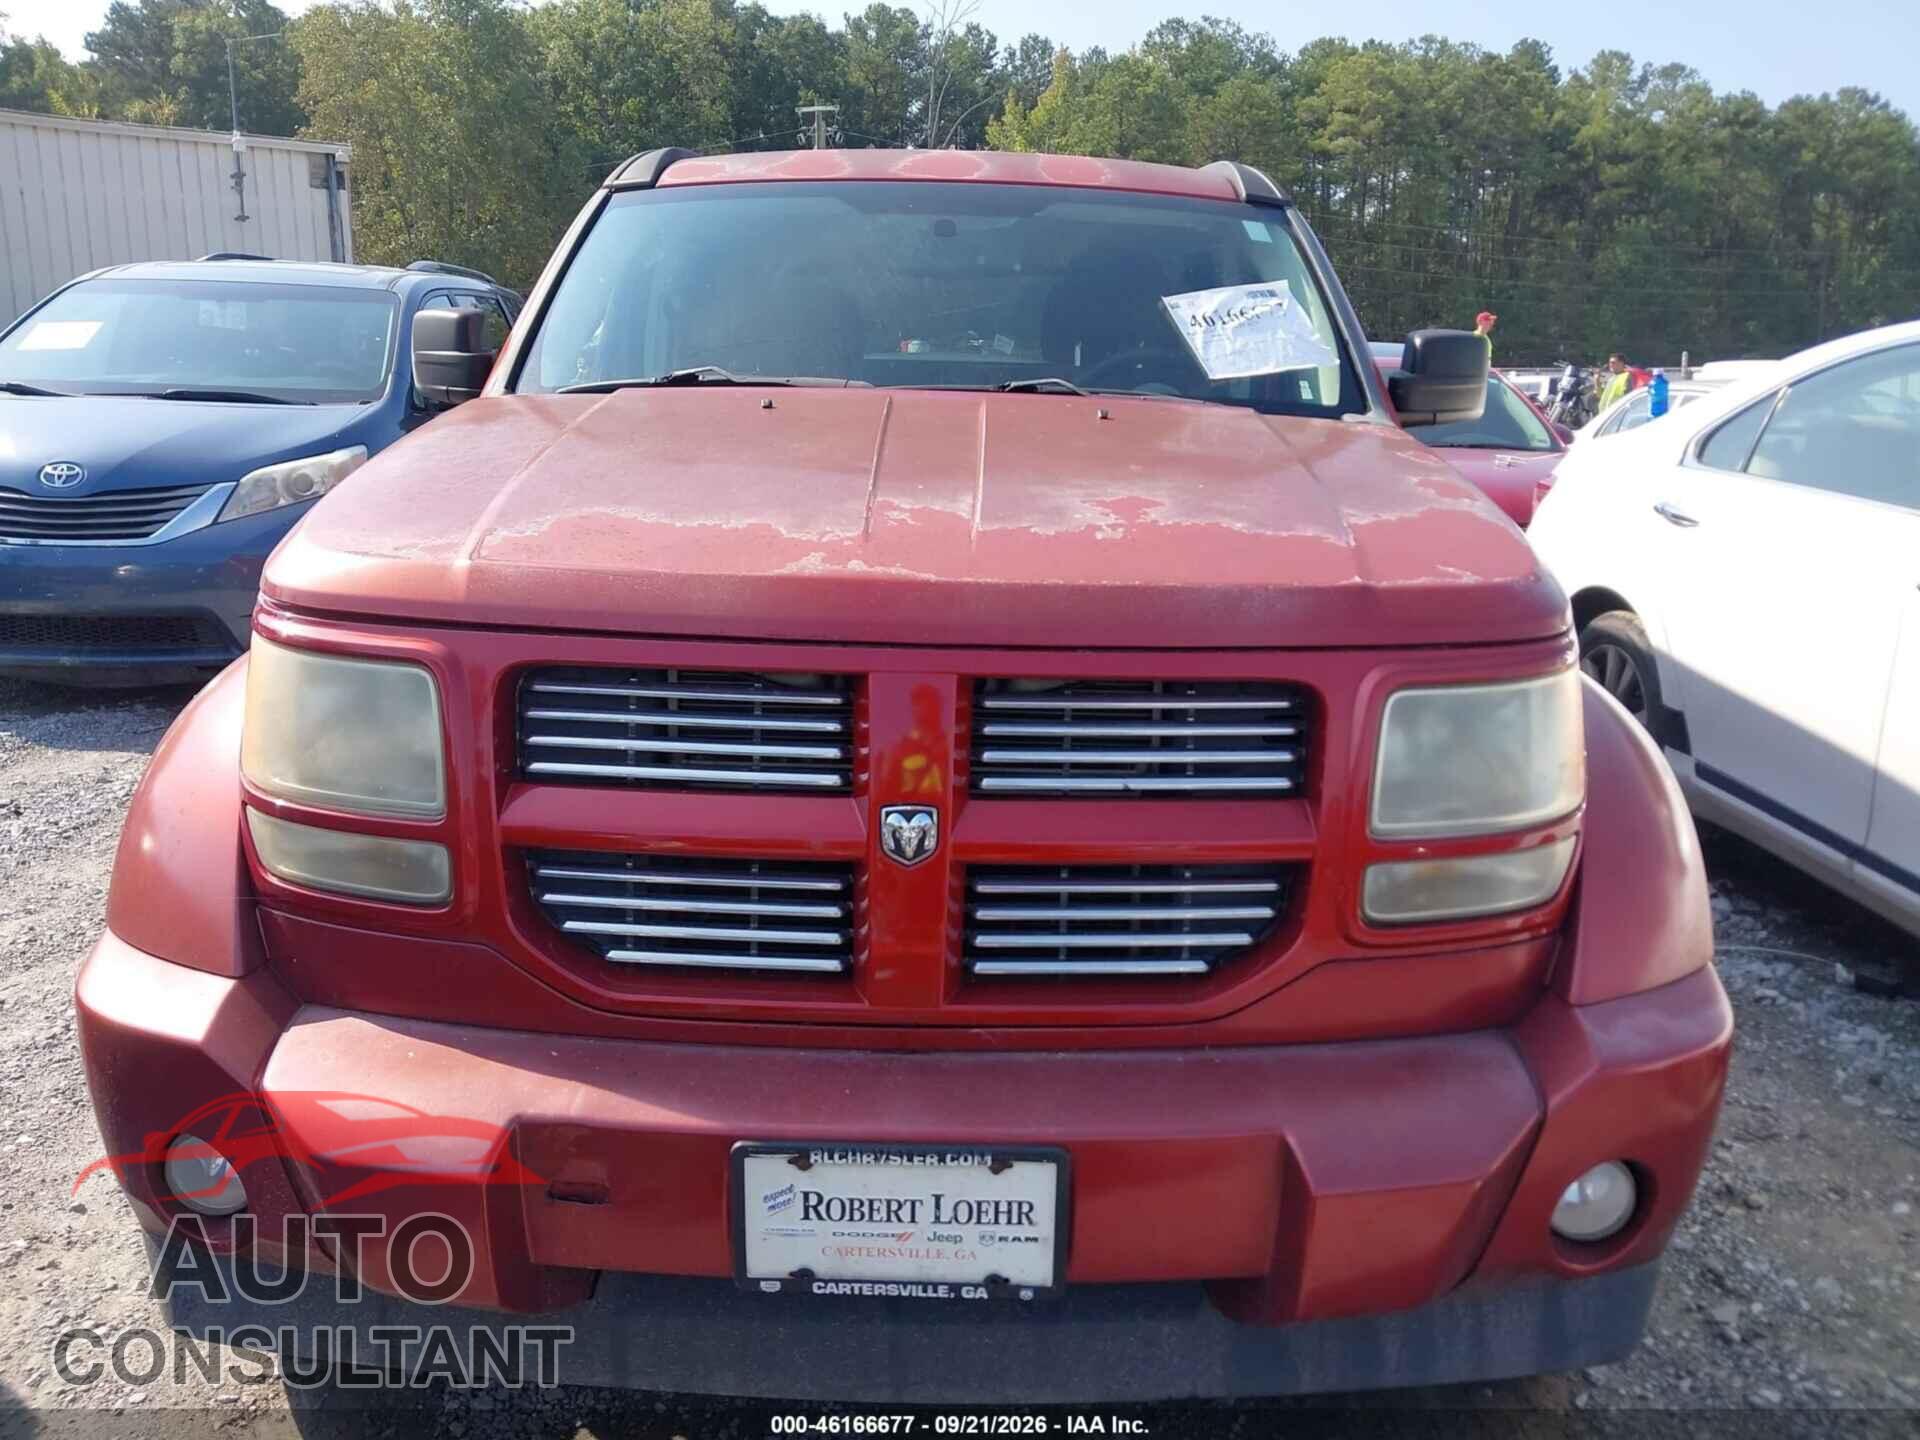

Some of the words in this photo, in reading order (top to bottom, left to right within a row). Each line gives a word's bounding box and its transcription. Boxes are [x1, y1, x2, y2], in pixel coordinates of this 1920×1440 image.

[800, 1190, 924, 1223] ROBERT
[931, 1193, 1037, 1226] LOEHR
[927, 1231, 963, 1244] Jeep
[954, 1249, 977, 1261] GA
[961, 1286, 989, 1299] GA
